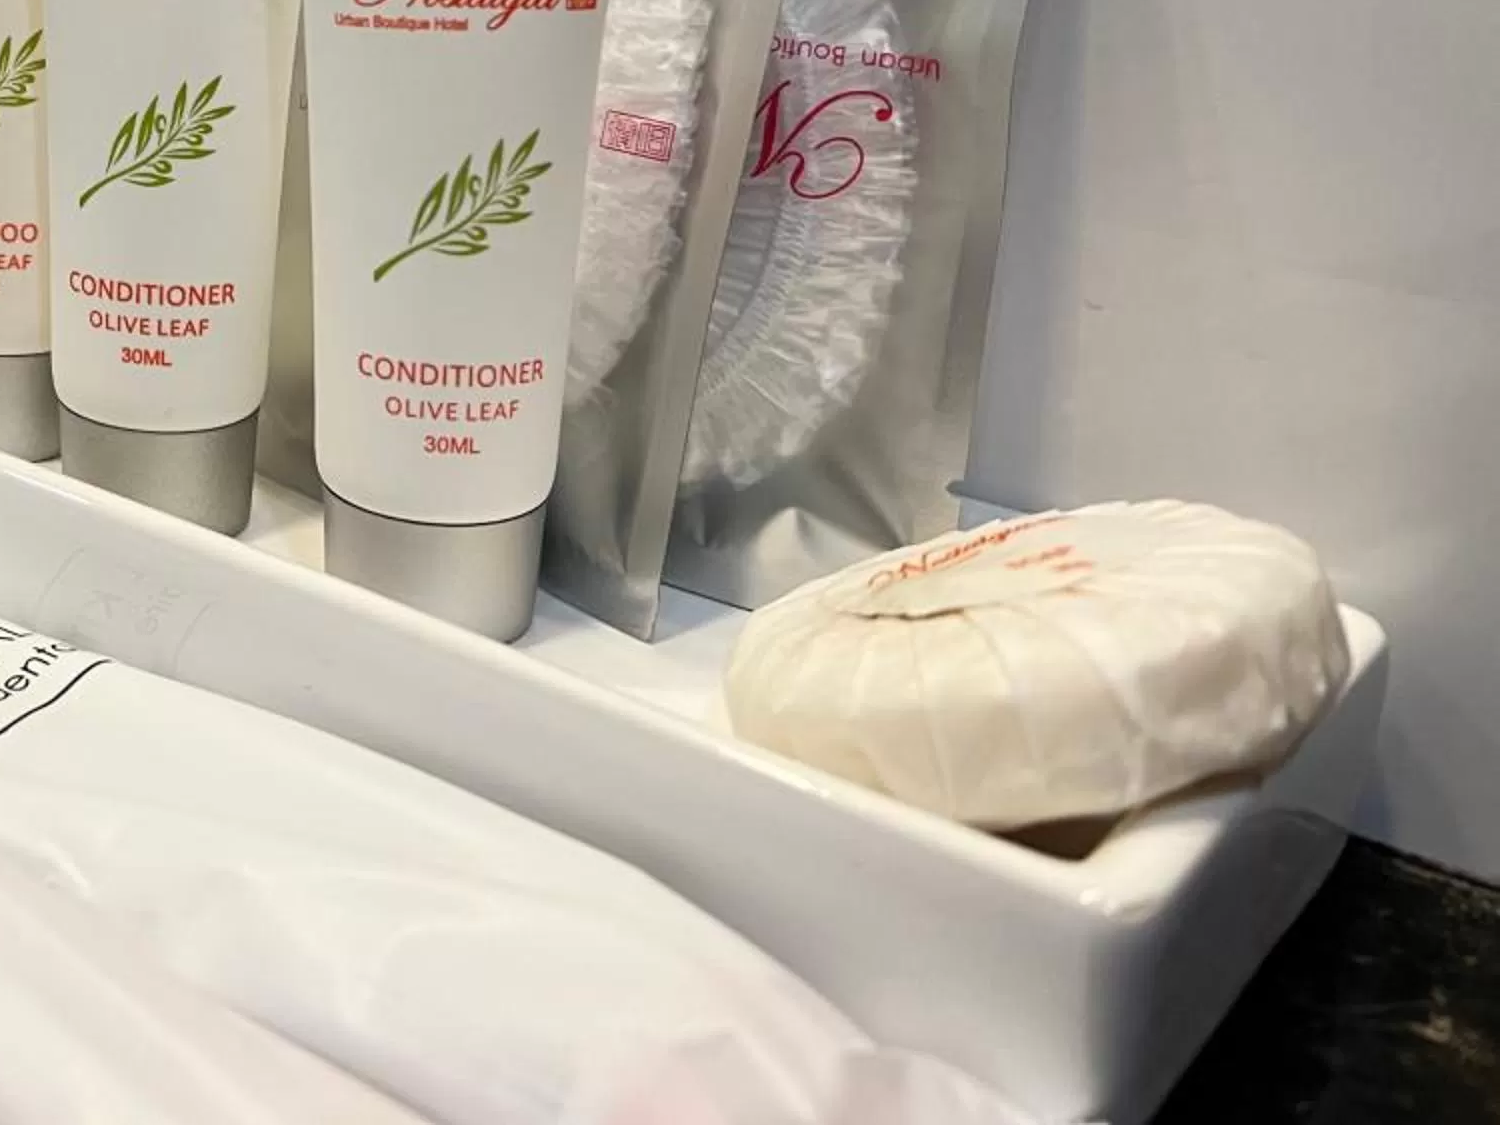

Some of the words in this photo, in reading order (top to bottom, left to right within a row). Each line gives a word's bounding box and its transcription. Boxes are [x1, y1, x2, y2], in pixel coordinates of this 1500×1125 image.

[861, 49, 941, 83] Urban
[69, 270, 236, 307] CONDITIONER
[89, 309, 150, 337] OLIVE
[156, 318, 210, 338] LEAF
[121, 346, 173, 367] 30ML
[357, 352, 545, 388] CONDITIONER
[385, 395, 459, 423] OLIVE
[465, 399, 520, 422] LEAF
[423, 434, 482, 455] 30ML
